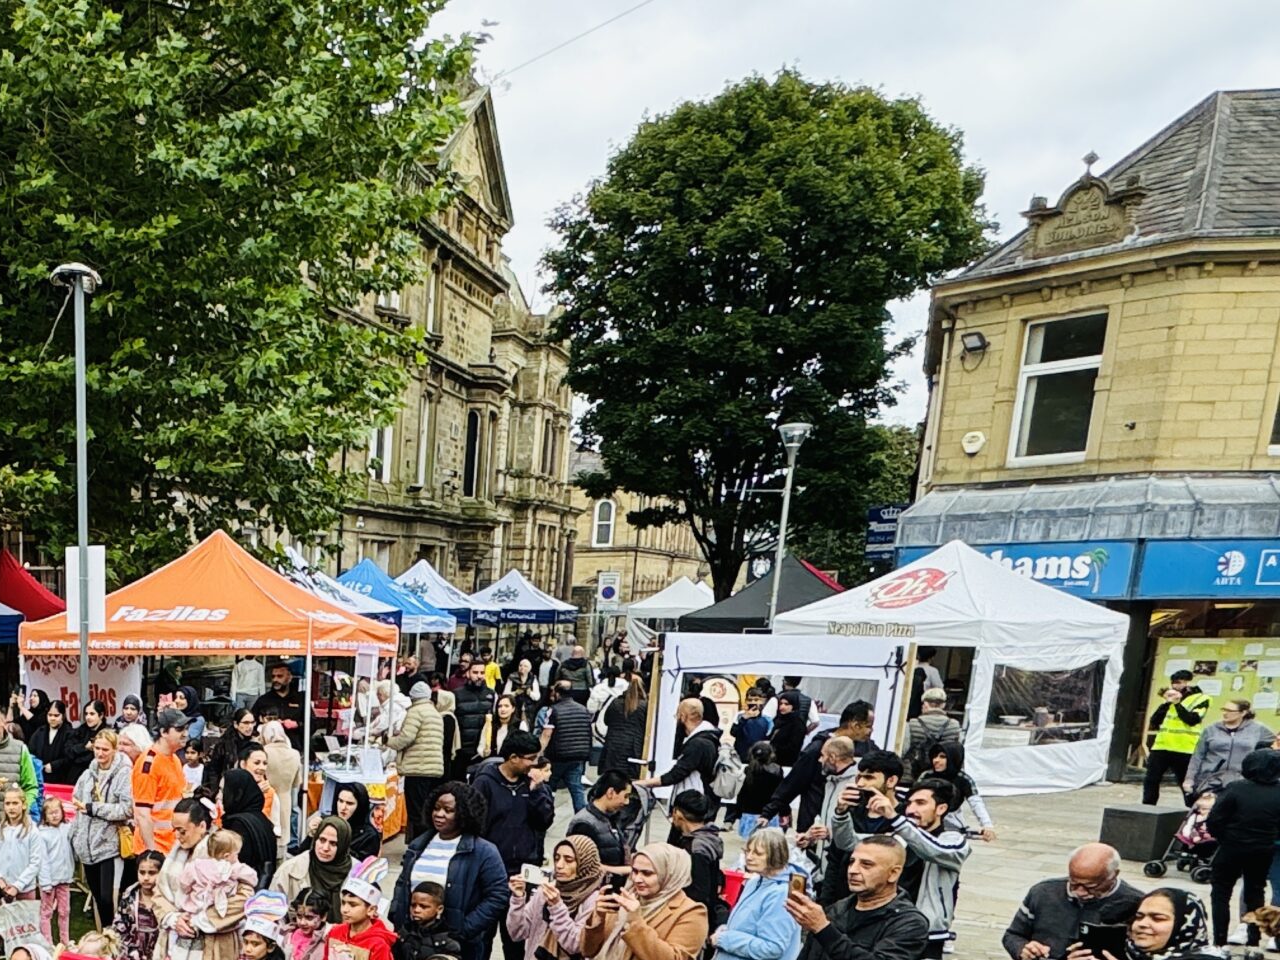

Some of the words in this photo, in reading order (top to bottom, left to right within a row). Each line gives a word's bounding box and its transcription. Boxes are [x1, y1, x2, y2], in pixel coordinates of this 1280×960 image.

[986, 550, 1092, 580] hams
[110, 605, 230, 622] Fazilas
[885, 623, 915, 638] Pizza
[60, 683, 116, 722] Failas
